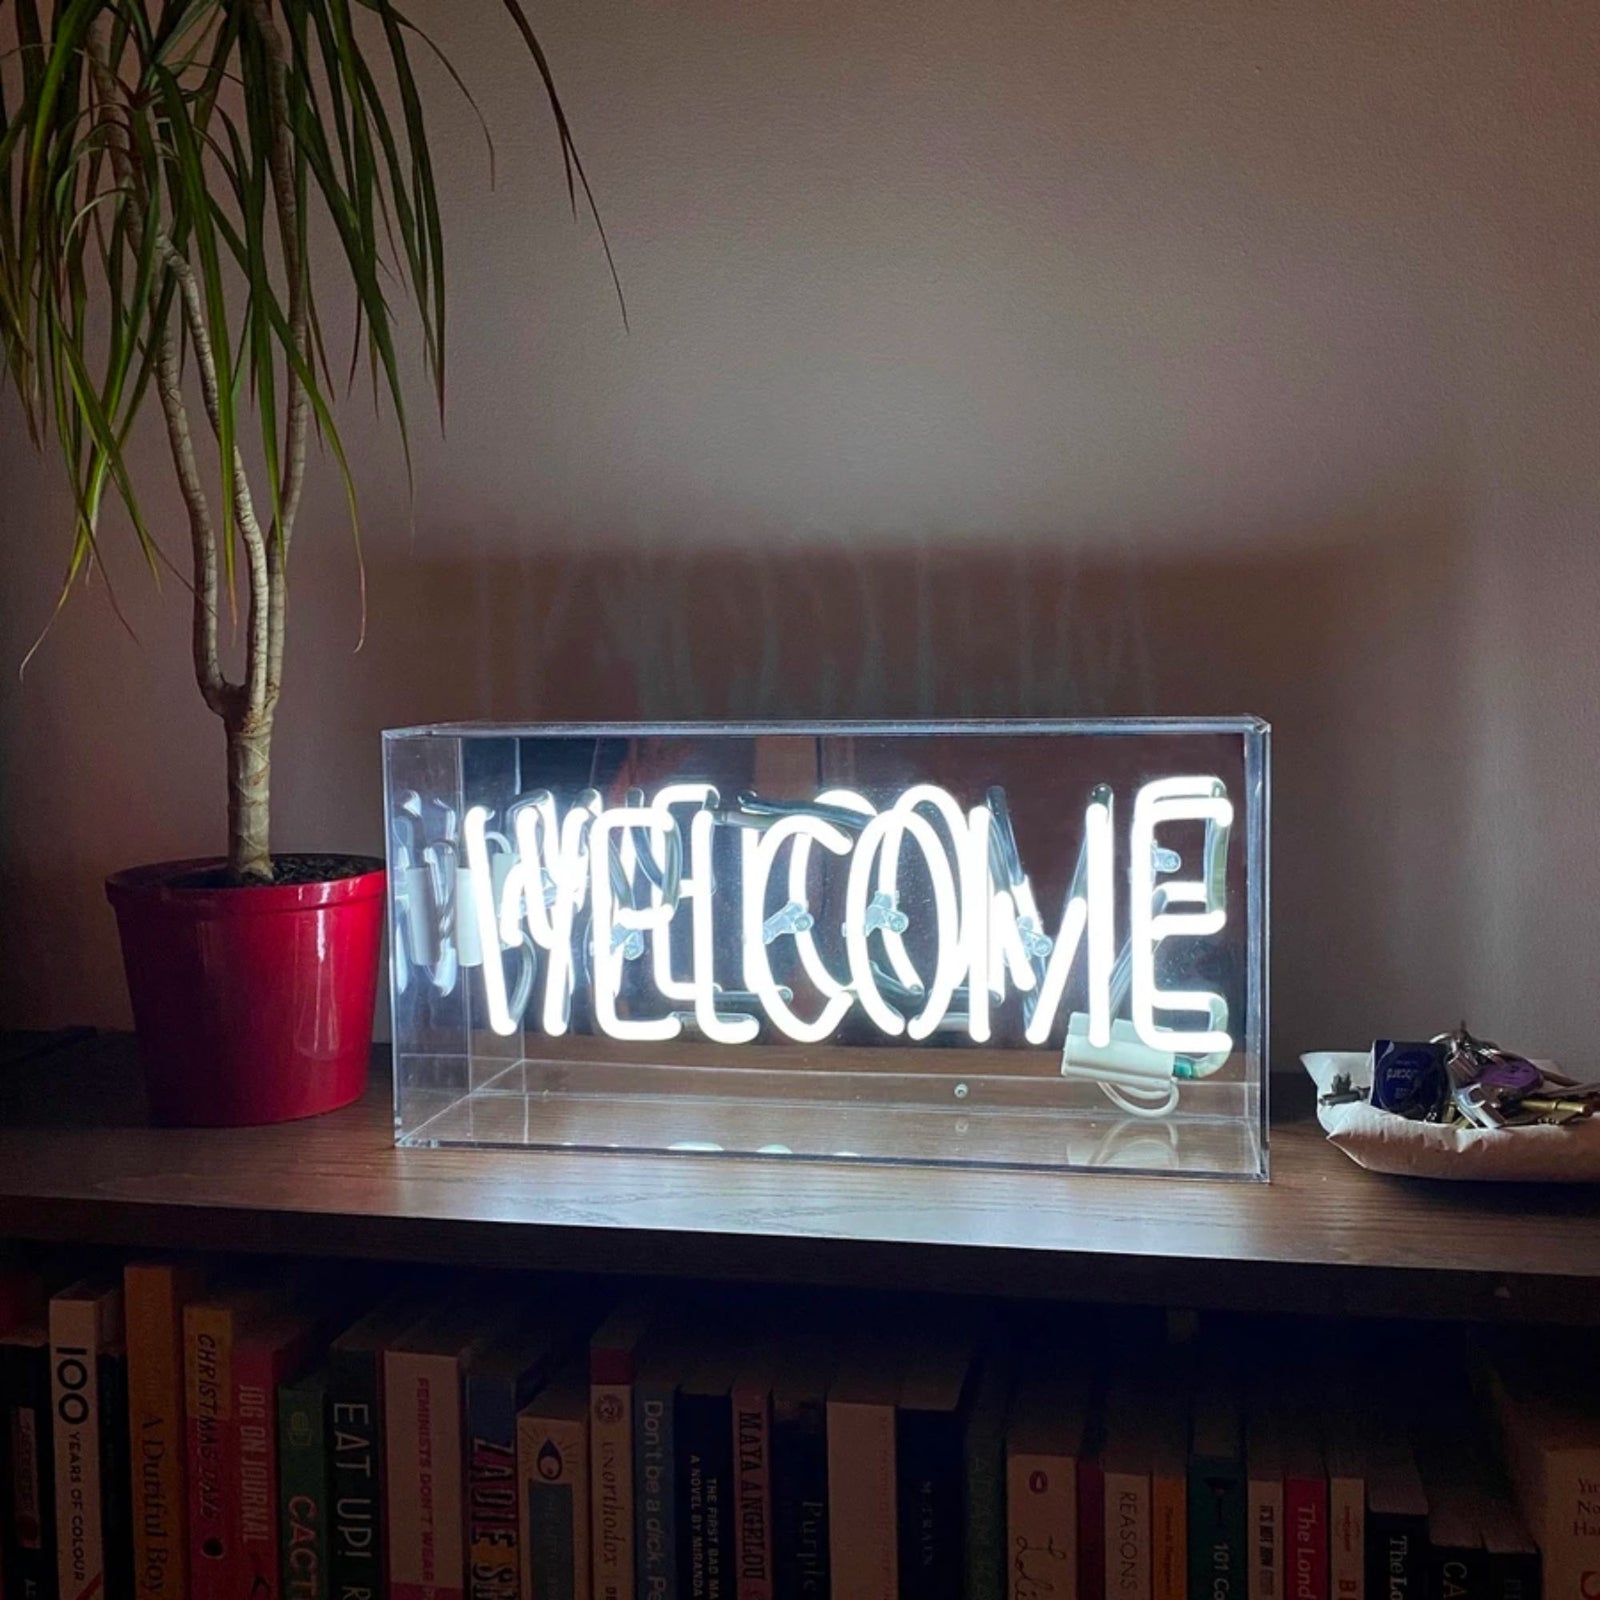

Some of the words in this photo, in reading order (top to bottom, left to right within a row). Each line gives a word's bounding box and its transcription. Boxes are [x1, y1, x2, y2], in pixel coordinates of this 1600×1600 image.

[464, 784, 1235, 1055] WELCOME
[56, 1347, 89, 1425] 100
[197, 1333, 220, 1459] CHRISTMAS
[238, 1385, 266, 1418] JOG
[142, 1412, 163, 1431] A
[240, 1425, 266, 1452] ON
[333, 1403, 372, 1479] EAT
[417, 1377, 433, 1468] FEMINISTS
[644, 1400, 663, 1459] Don't
[739, 1411, 763, 1472] MAYA
[68, 1431, 82, 1483] YEARS
[646, 1466, 663, 1493] be
[690, 1455, 701, 1464] A
[71, 1489, 83, 1510] OF
[142, 1439, 168, 1538] Dutiful
[240, 1456, 268, 1544] JOURNAL
[419, 1473, 434, 1525] DON'T
[470, 1438, 517, 1549] ZADIE
[646, 1499, 661, 1512] a
[690, 1468, 701, 1510] NOVEL
[706, 1478, 718, 1502] THE
[71, 1515, 86, 1581] COLOUR
[336, 1497, 373, 1560] UP!
[646, 1517, 664, 1569] dick.
[691, 1514, 702, 1530] BY
[707, 1506, 718, 1542] FIRST
[741, 1480, 765, 1581] ANGELOU
[795, 1500, 825, 1592] Purple
[1119, 1491, 1139, 1590] REASONS
[1297, 1504, 1317, 1542] The
[142, 1548, 169, 1594] Boy
[422, 1531, 435, 1582] WEAR
[692, 1535, 702, 1597] MIRANDA
[708, 1548, 719, 1574] BAD
[1212, 1542, 1228, 1571] 101
[1388, 1535, 1409, 1574] The
